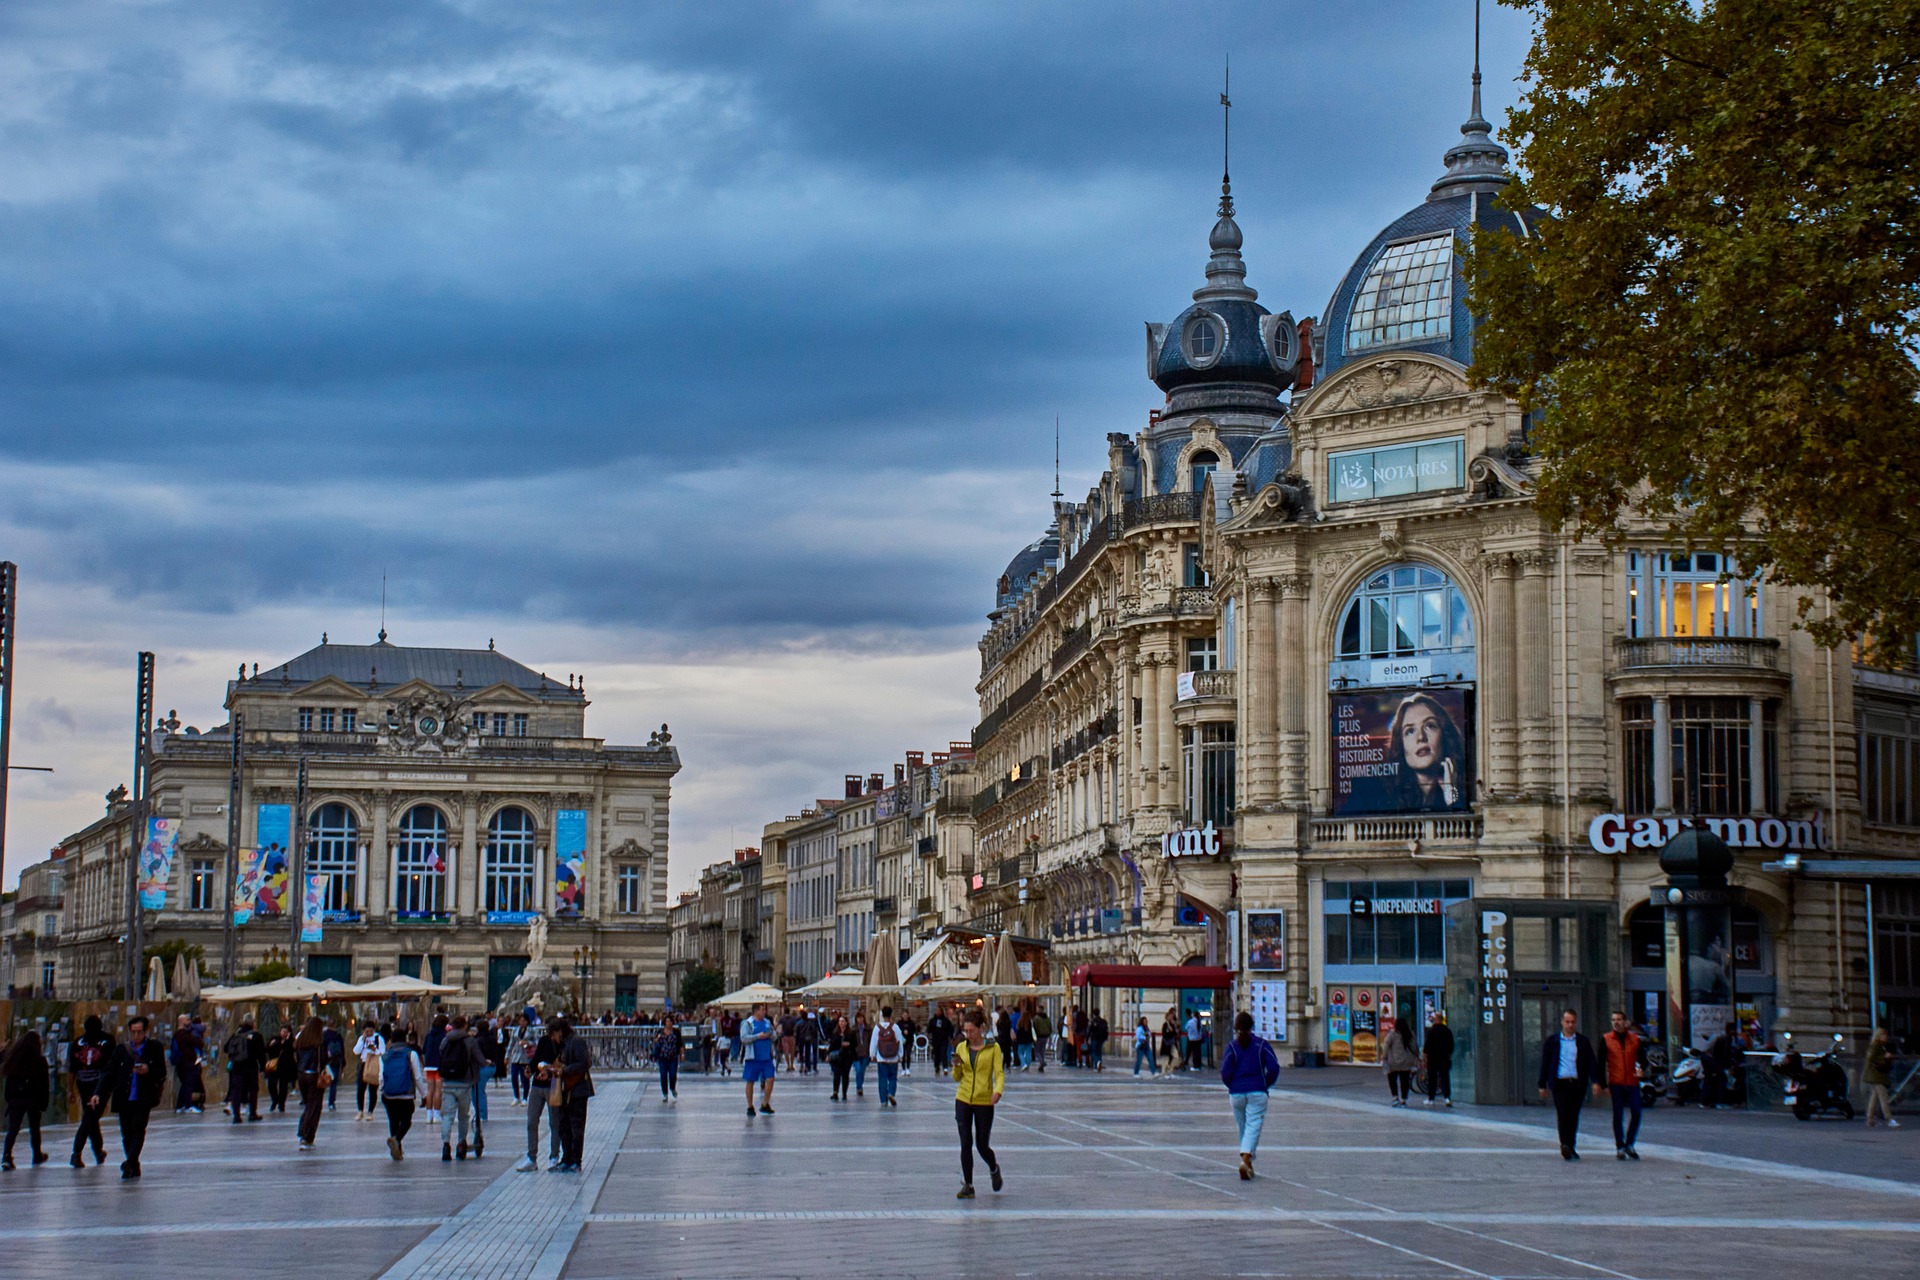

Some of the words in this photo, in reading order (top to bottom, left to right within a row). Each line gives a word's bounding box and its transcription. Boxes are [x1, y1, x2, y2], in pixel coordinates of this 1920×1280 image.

[1371, 460, 1448, 483] NOTAIRES
[1338, 705, 1353, 718] LES
[1339, 720, 1361, 733] PLUS
[1339, 734, 1370, 748] BELLES
[1339, 749, 1384, 763] HISTOIRES
[1340, 762, 1400, 778] COMMENCENT
[1340, 781, 1352, 793] ICI
[1371, 899, 1434, 914] INDEPENDENCE
[1481, 911, 1507, 1024] Parking
